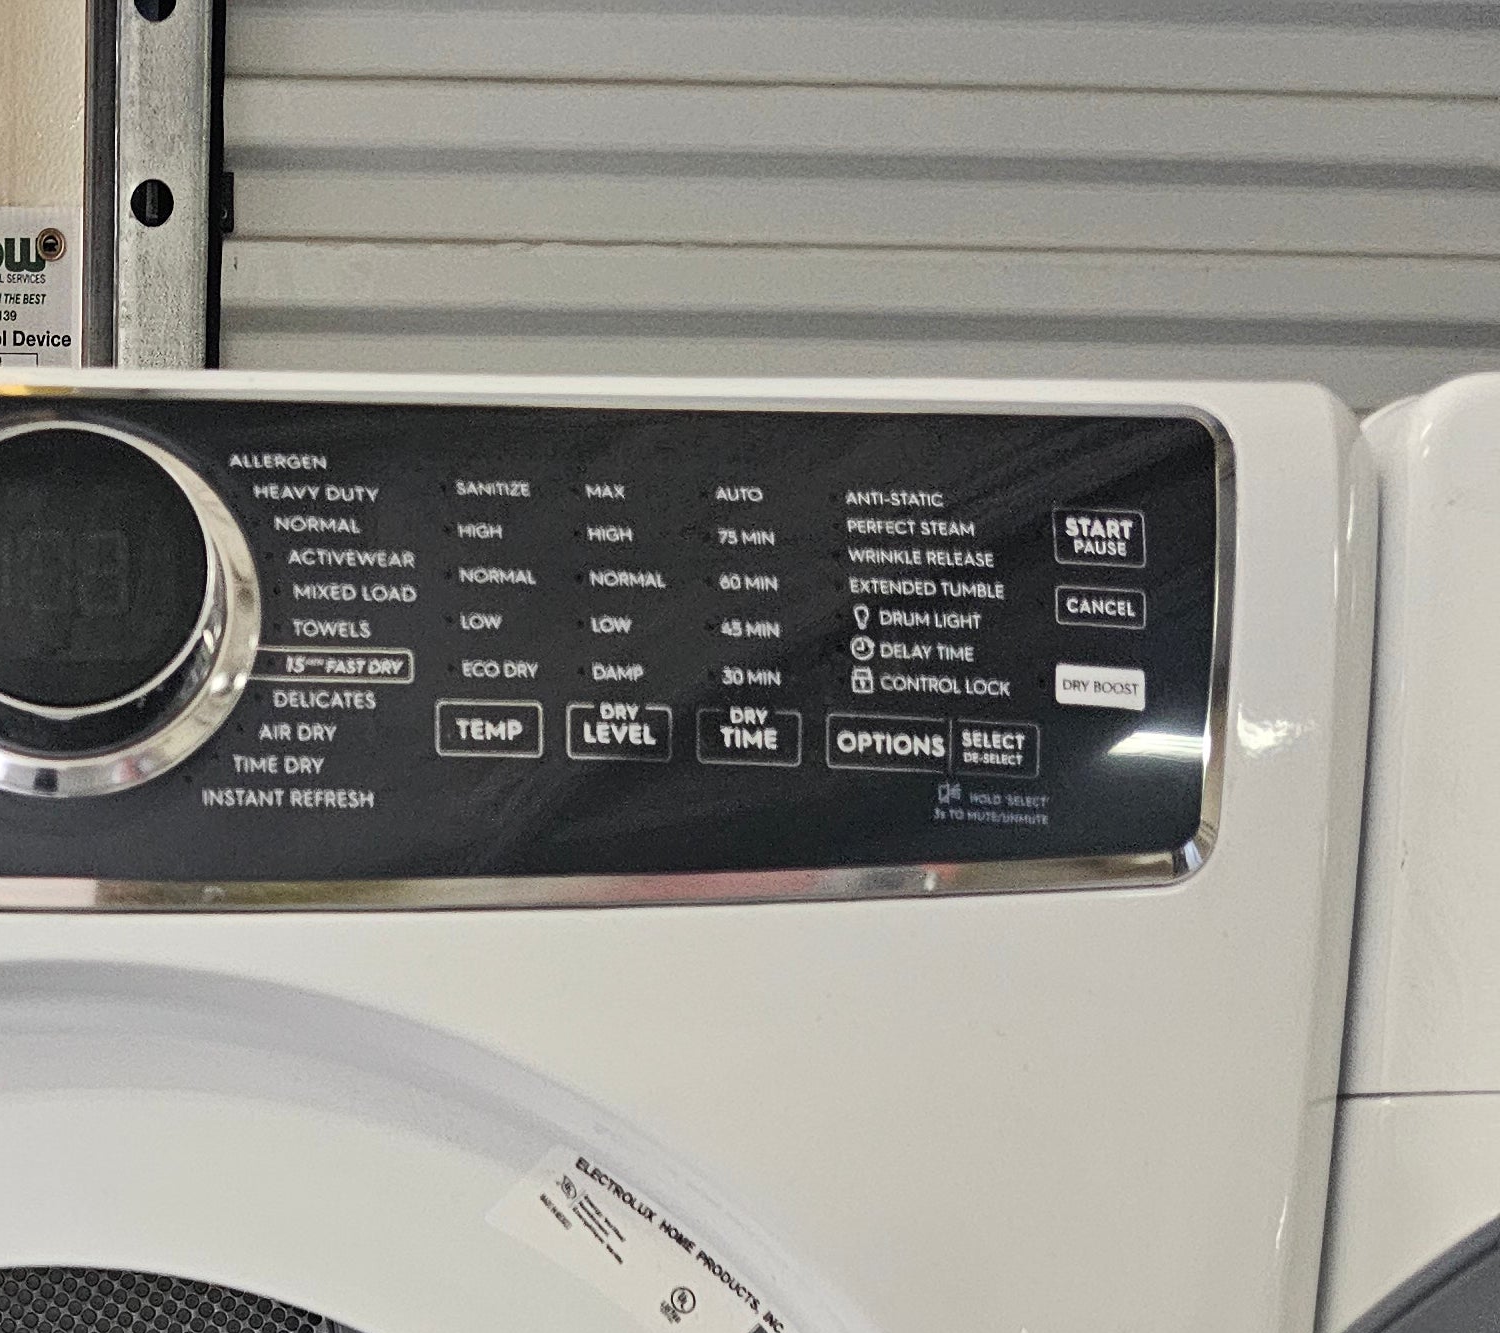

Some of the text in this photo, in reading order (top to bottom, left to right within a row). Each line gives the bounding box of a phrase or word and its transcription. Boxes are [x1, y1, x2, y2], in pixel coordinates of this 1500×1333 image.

[6, 273, 47, 285] SERVICES
[4, 293, 21, 305] THE
[22, 293, 47, 305] BEST
[12, 330, 72, 348] Device
[229, 453, 328, 470] ALLERGEN
[253, 484, 379, 502] HEAVY DUTY
[455, 479, 531, 498] SANITIZE
[585, 481, 626, 499] MAX
[715, 486, 763, 502] AUTO
[845, 490, 945, 508] ANTI-STATIC
[273, 515, 361, 534] NORMAL
[457, 522, 503, 539] HIGH
[586, 525, 633, 542] HIGH
[846, 519, 975, 537] PERFECT STEAM
[1065, 516, 1133, 540] START
[718, 528, 775, 547] 75 MIN
[1073, 539, 1127, 557] PAUSE
[288, 548, 415, 568] ACTIVEWEAR
[848, 549, 995, 568] WRINKLE RELEASE
[458, 566, 536, 585] NORMAL
[588, 569, 666, 589] NORMAL
[718, 572, 778, 592] 60 MIN
[293, 583, 417, 602] MIXED LOAD
[849, 577, 1005, 600] EXTENDED TUMBLE
[1066, 597, 1136, 617] CANCEL
[293, 619, 372, 639] TOWELS
[460, 611, 502, 630] LOW
[590, 615, 632, 634] LOW
[720, 619, 781, 639] 45 MIN
[879, 609, 982, 630] DRUM LIGHT
[879, 642, 975, 663] DELAY TIME
[325, 657, 366, 675] FAST
[367, 658, 404, 675] DRY
[461, 659, 539, 679] ECO DRY
[591, 661, 644, 681] DAMP
[721, 667, 782, 687] 30 MIN
[880, 675, 1011, 697] CONTROL LOCK
[1062, 679, 1140, 696] DRY BOOST
[272, 689, 377, 710] DELICATES
[600, 702, 639, 721] DRY
[729, 705, 768, 725] DRY
[259, 722, 337, 742] AIR DRY
[455, 718, 524, 742] TEMP
[583, 721, 657, 746] LEVEL
[719, 725, 778, 750] TIME
[961, 728, 1026, 750] SELECT
[836, 729, 946, 758] OPTIONS
[232, 753, 325, 775] TIME DRY
[963, 751, 1024, 766] DE-SELECT
[201, 786, 376, 809] INSTANT REFRESH
[948, 808, 964, 821] TO
[573, 1156, 658, 1223] ELECTROLUX
[656, 1218, 697, 1255] HOME
[696, 1251, 763, 1314] PRODUCTS,
